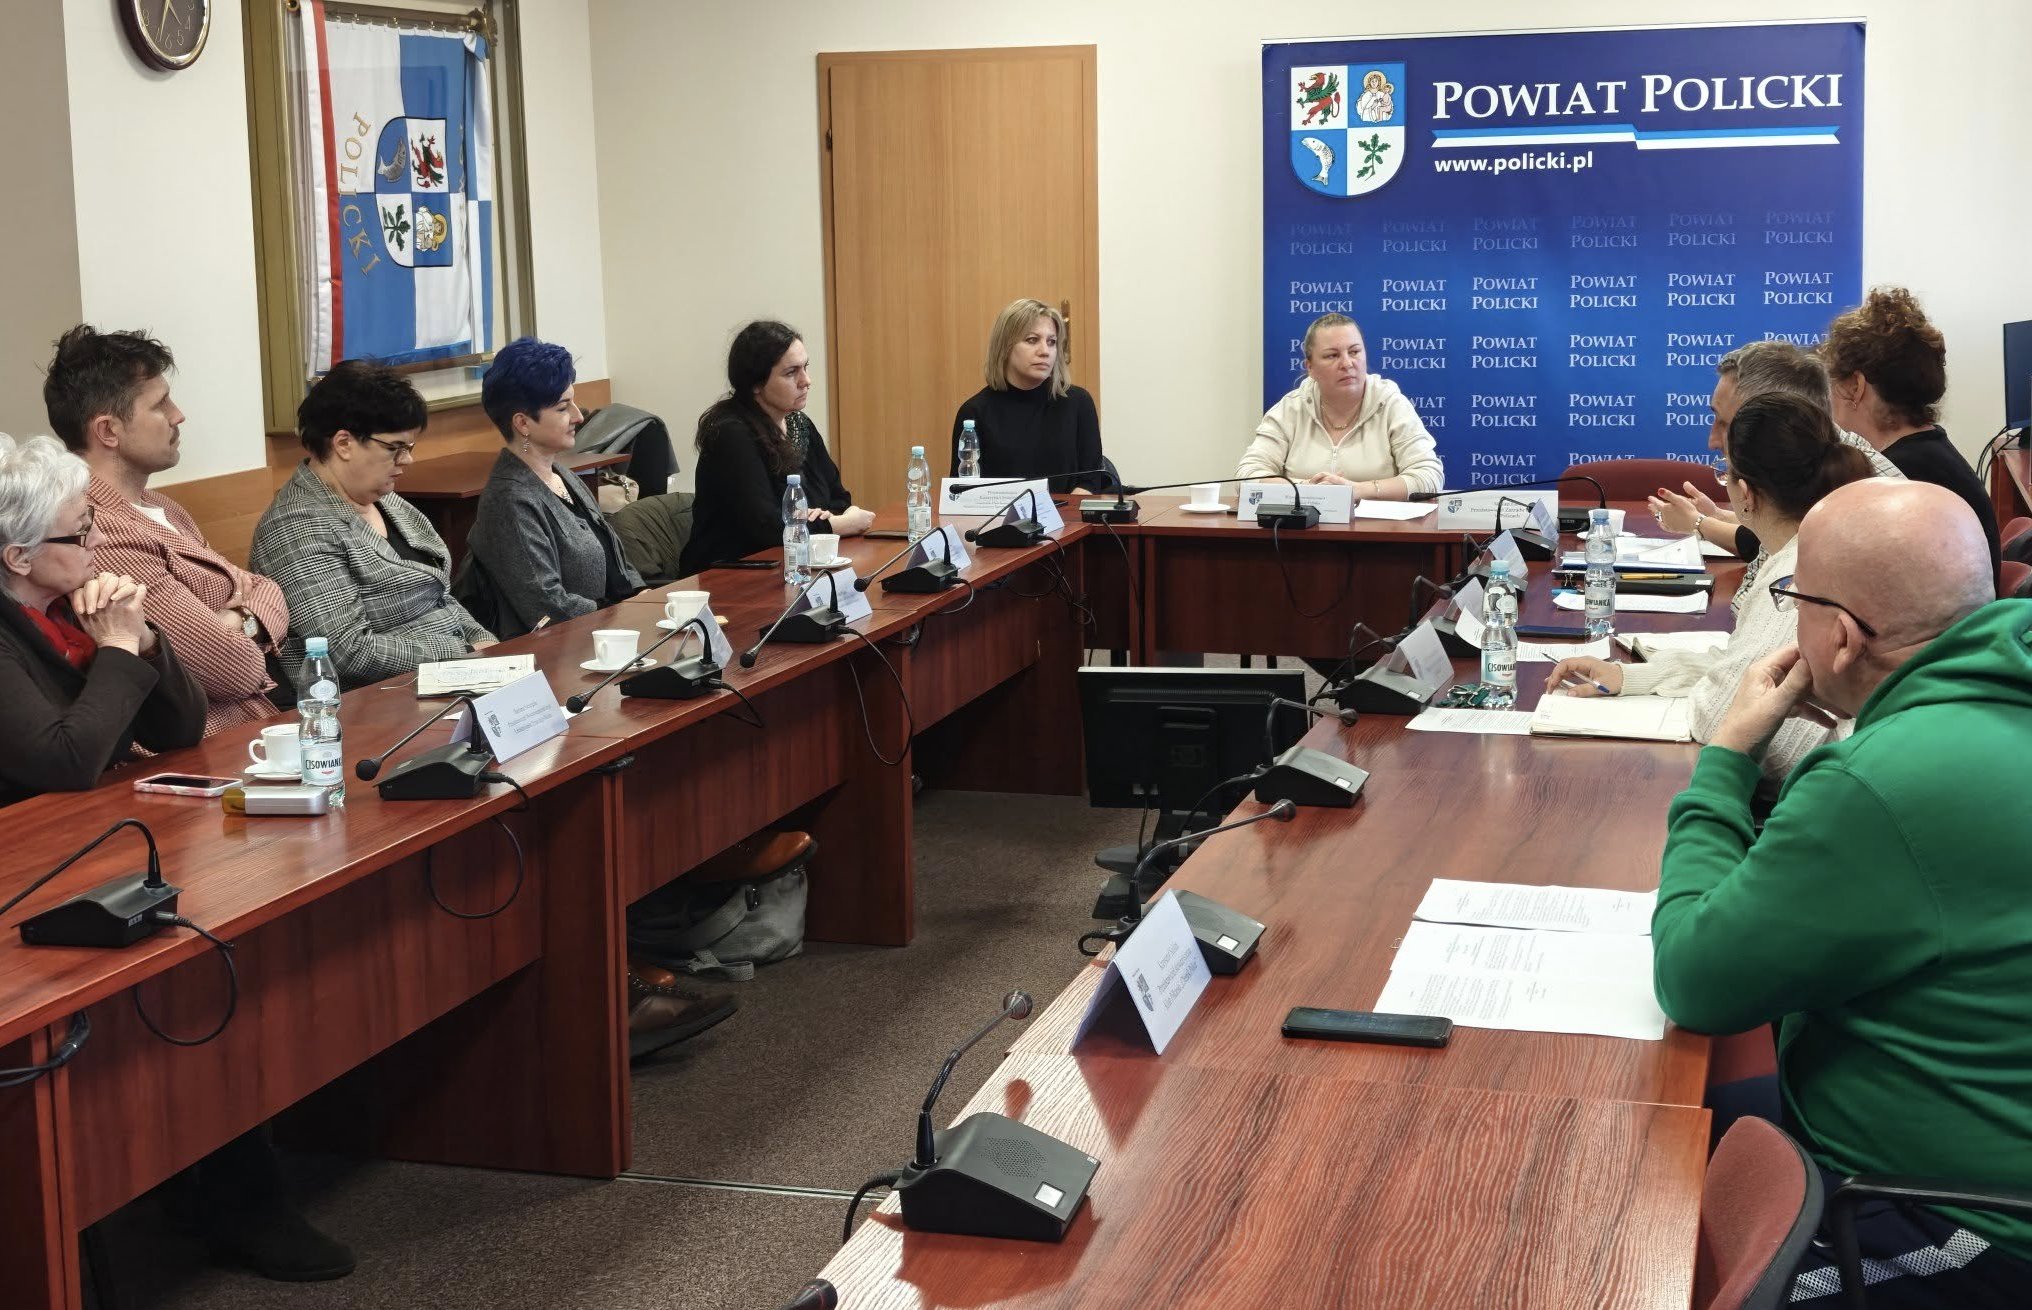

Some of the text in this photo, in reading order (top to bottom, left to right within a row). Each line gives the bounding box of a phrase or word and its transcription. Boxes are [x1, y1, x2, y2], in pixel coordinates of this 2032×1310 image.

[1432, 73, 1843, 119] POWIAT POLICKI
[1434, 150, 1594, 175] www.policki.pl
[339, 112, 381, 276] POLICKI
[1473, 237, 1538, 250] POLICKI
[1571, 235, 1637, 248] POLICKI
[1668, 232, 1736, 246] POLICKI
[1765, 230, 1833, 244] POLICKI
[1290, 241, 1353, 255] POLICKI
[1383, 239, 1447, 252] POLICKI
[1473, 277, 1538, 290] POWIAT
[1571, 275, 1637, 288] POWIAT
[1668, 273, 1736, 286] POWIAT
[1765, 272, 1833, 285] POWIAT
[1290, 281, 1353, 294] POWIAT
[1382, 279, 1446, 292] POWIAT
[1472, 296, 1538, 309] POLICKI
[1570, 294, 1637, 308] POLICKI
[1667, 292, 1736, 306] POLICKI
[1764, 290, 1833, 304] POLICKI
[1290, 300, 1353, 313] POLICKI
[1382, 298, 1446, 311] POLICKI
[1382, 337, 1446, 350] POWIAT
[1472, 336, 1538, 349] POWIAT
[1569, 335, 1637, 349] POWIAT
[1667, 333, 1735, 347] POWIAT
[1382, 356, 1446, 370] POLICKI
[1472, 355, 1538, 368] POLICKI
[1569, 353, 1637, 367] POLICKI
[1666, 352, 1722, 366] POLIC
[1472, 395, 1537, 408] POWIAT
[1569, 394, 1636, 407] POWIAT
[1666, 393, 1711, 406] POWI
[1471, 414, 1537, 427] POLICKI
[1568, 413, 1636, 426] POLICKI
[1472, 453, 1537, 466] POWIAT
[1471, 472, 1536, 486] POLICKI
